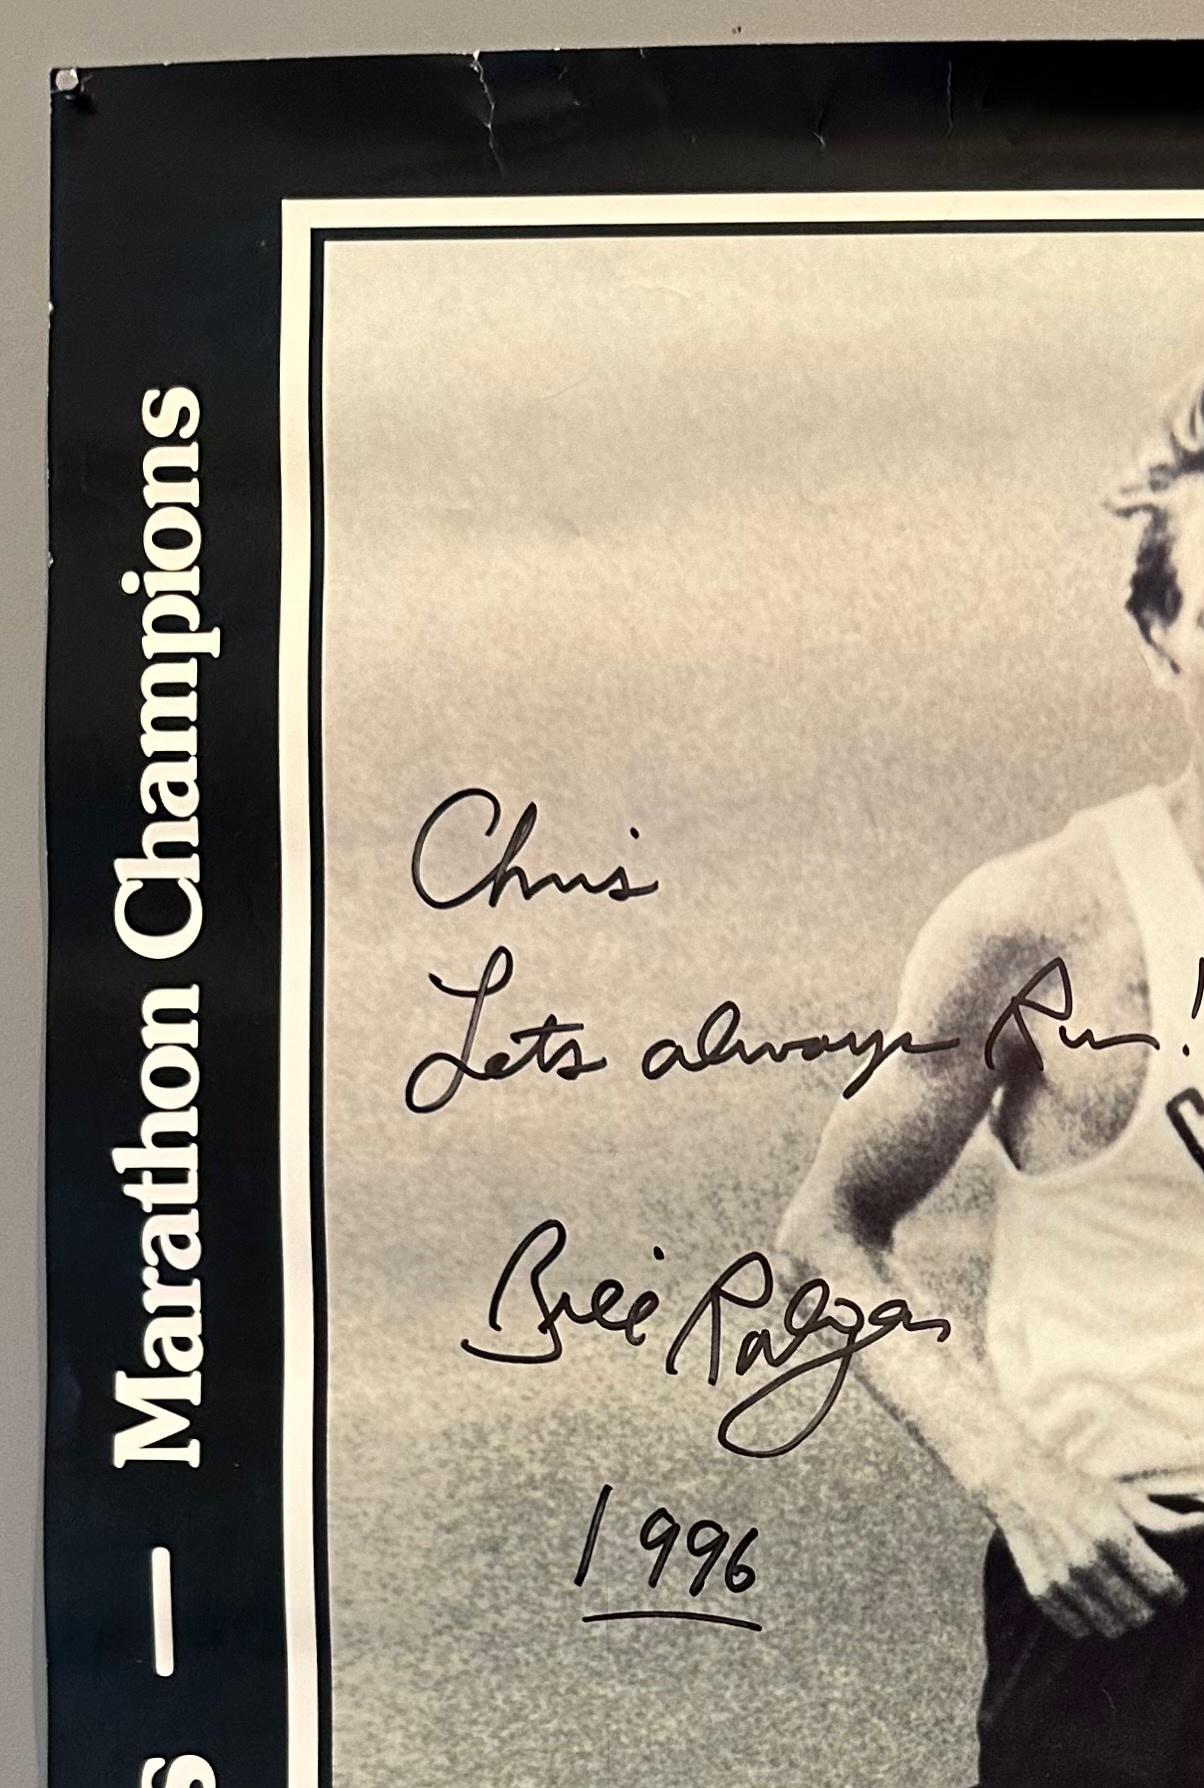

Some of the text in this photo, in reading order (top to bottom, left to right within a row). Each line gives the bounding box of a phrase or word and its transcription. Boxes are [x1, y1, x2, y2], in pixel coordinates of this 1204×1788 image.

[114, 387, 221, 959] Champions
[411, 787, 659, 910] Chris
[642, 1000, 960, 1100] always
[112, 984, 203, 1468] Marathon
[461, 1219, 665, 1364] Bill
[574, 1484, 760, 1598] 1996
